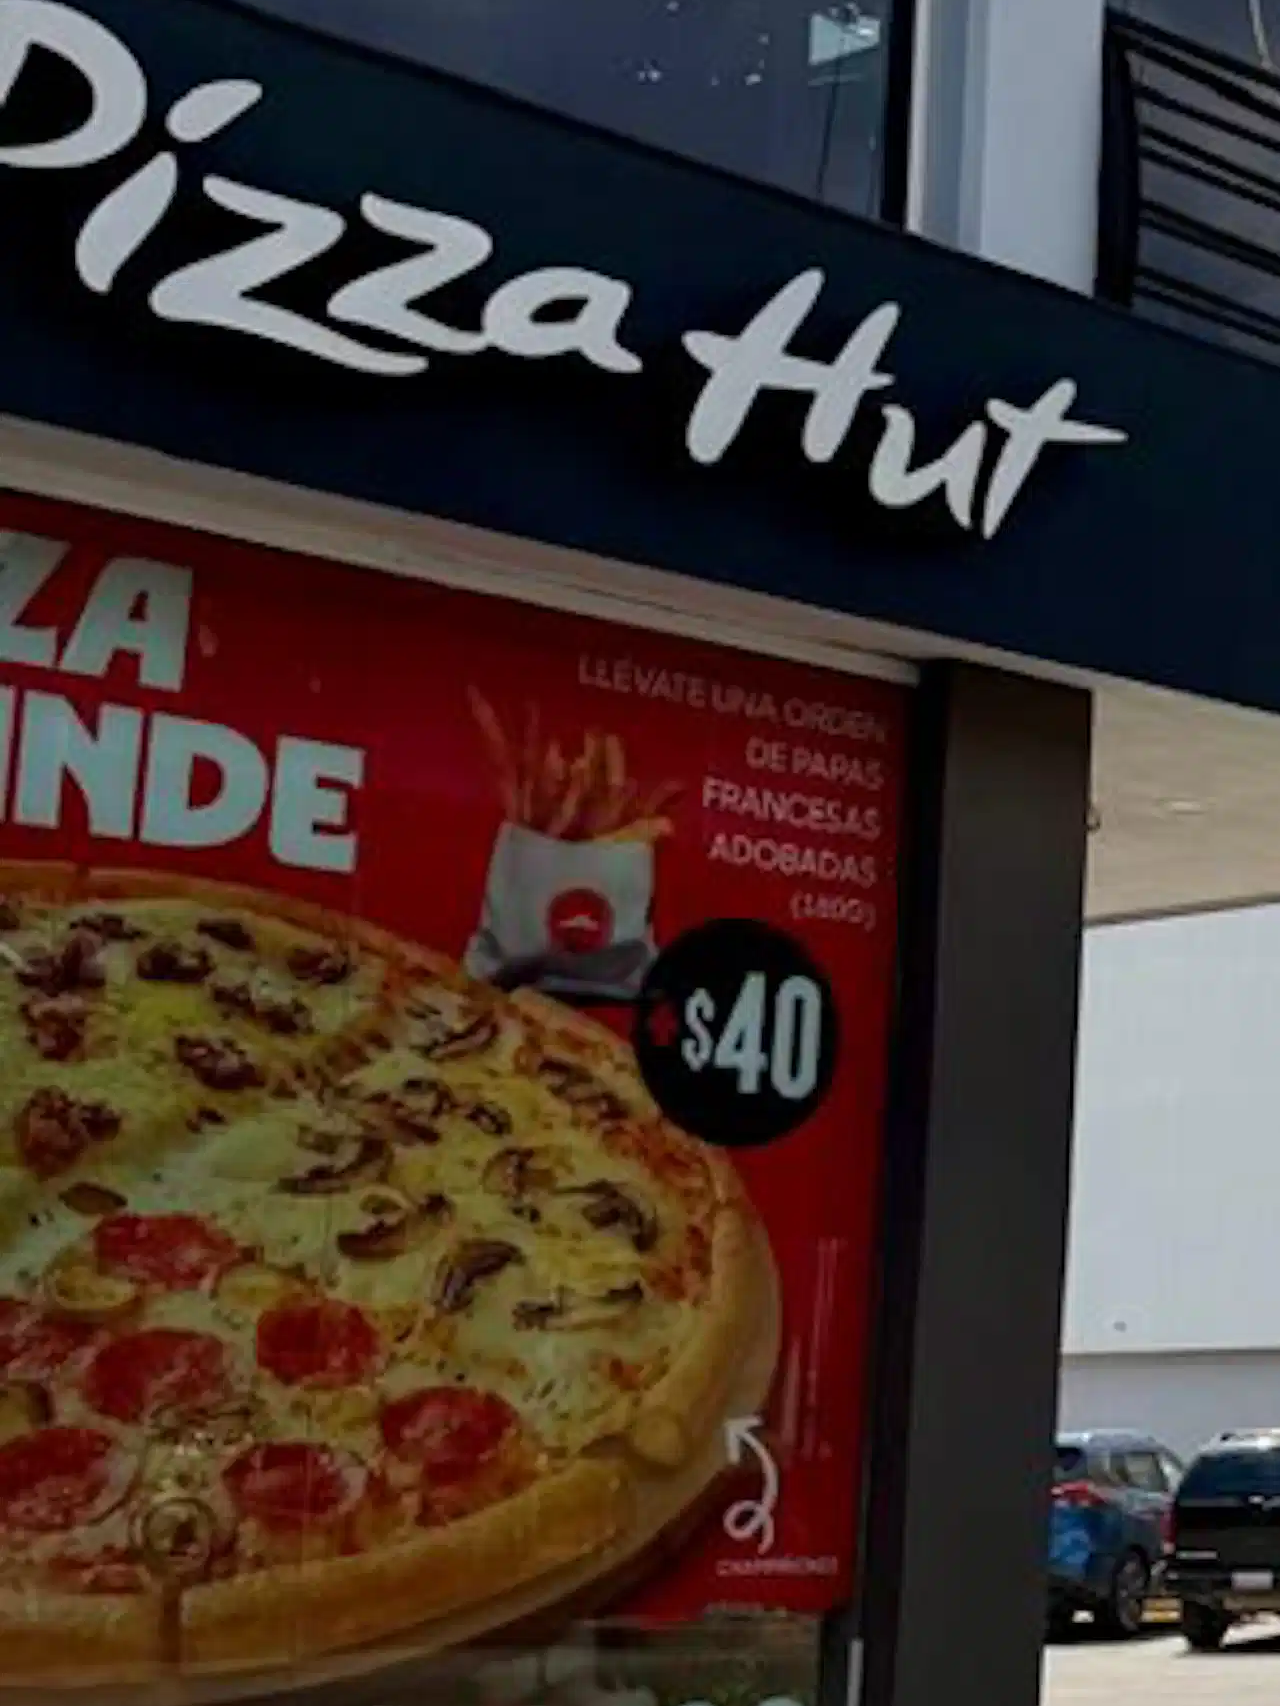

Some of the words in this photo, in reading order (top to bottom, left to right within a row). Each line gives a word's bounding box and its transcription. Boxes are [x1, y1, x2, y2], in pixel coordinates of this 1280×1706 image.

[681, 268, 1128, 539] Hut
[712, 681, 779, 721] UNA
[784, 697, 888, 743] ORDEN
[0, 685, 366, 874] NDE
[746, 736, 787, 773] DE
[793, 746, 884, 792] PAPAS
[702, 776, 881, 841] FRANCESAS
[708, 833, 877, 889] ADOBADAS
